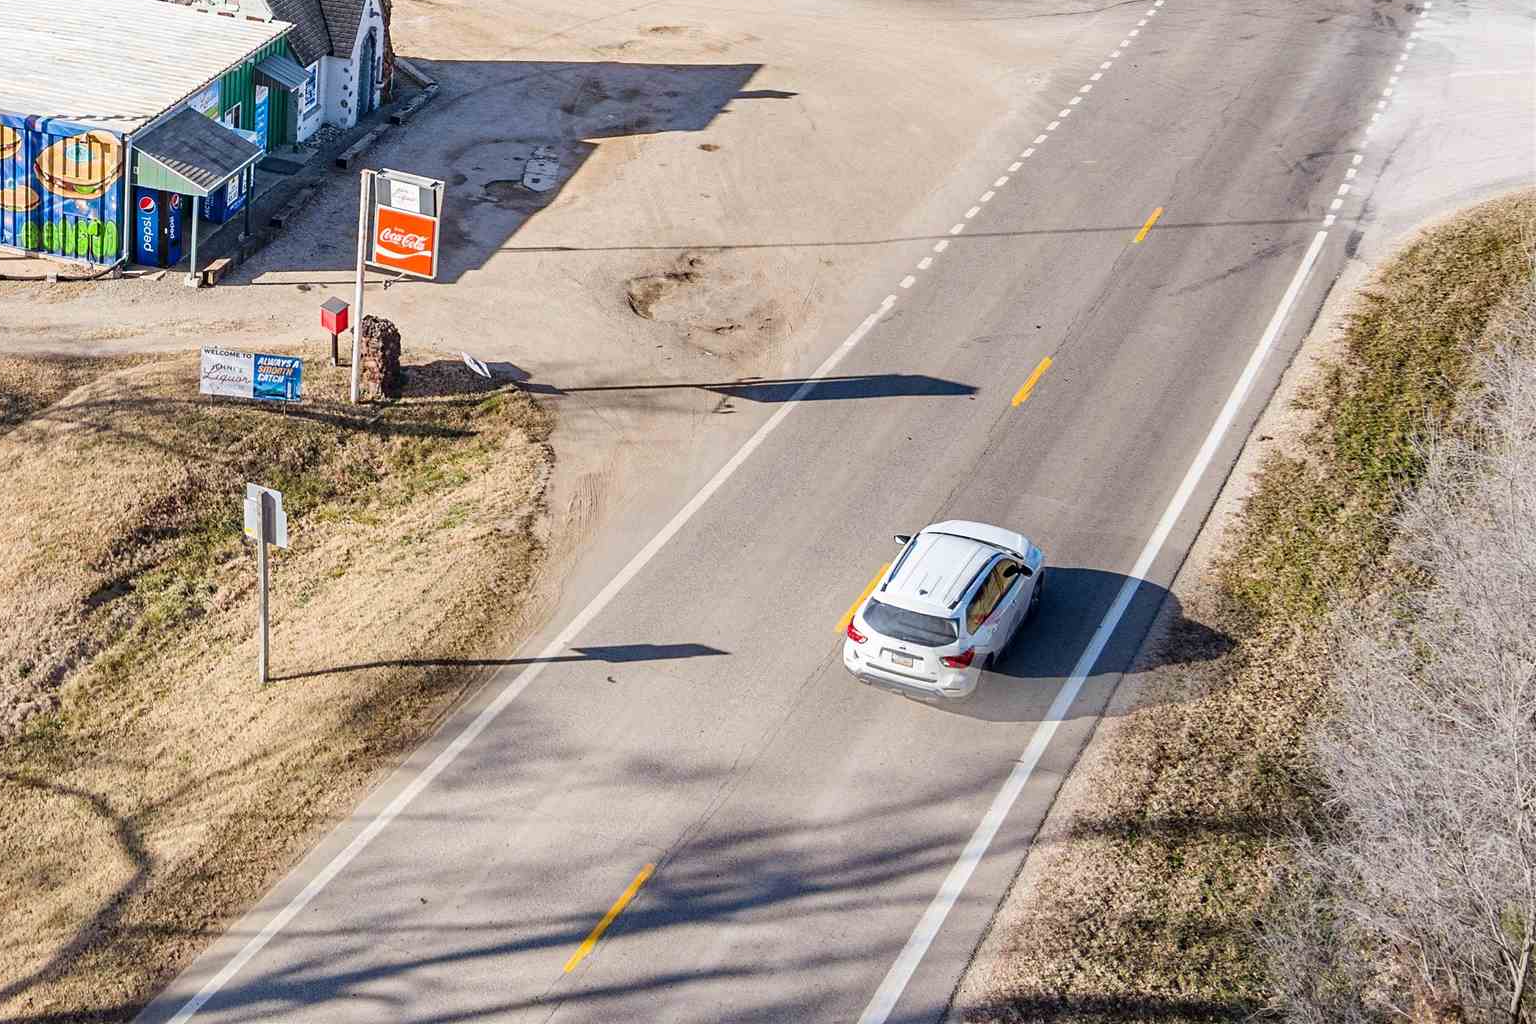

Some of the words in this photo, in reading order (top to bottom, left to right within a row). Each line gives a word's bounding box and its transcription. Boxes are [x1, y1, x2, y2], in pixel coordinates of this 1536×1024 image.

[141, 217, 154, 252] pepsi
[204, 349, 240, 359] WELCOME
[257, 357, 291, 367] ALWAYS
[292, 360, 300, 368] A
